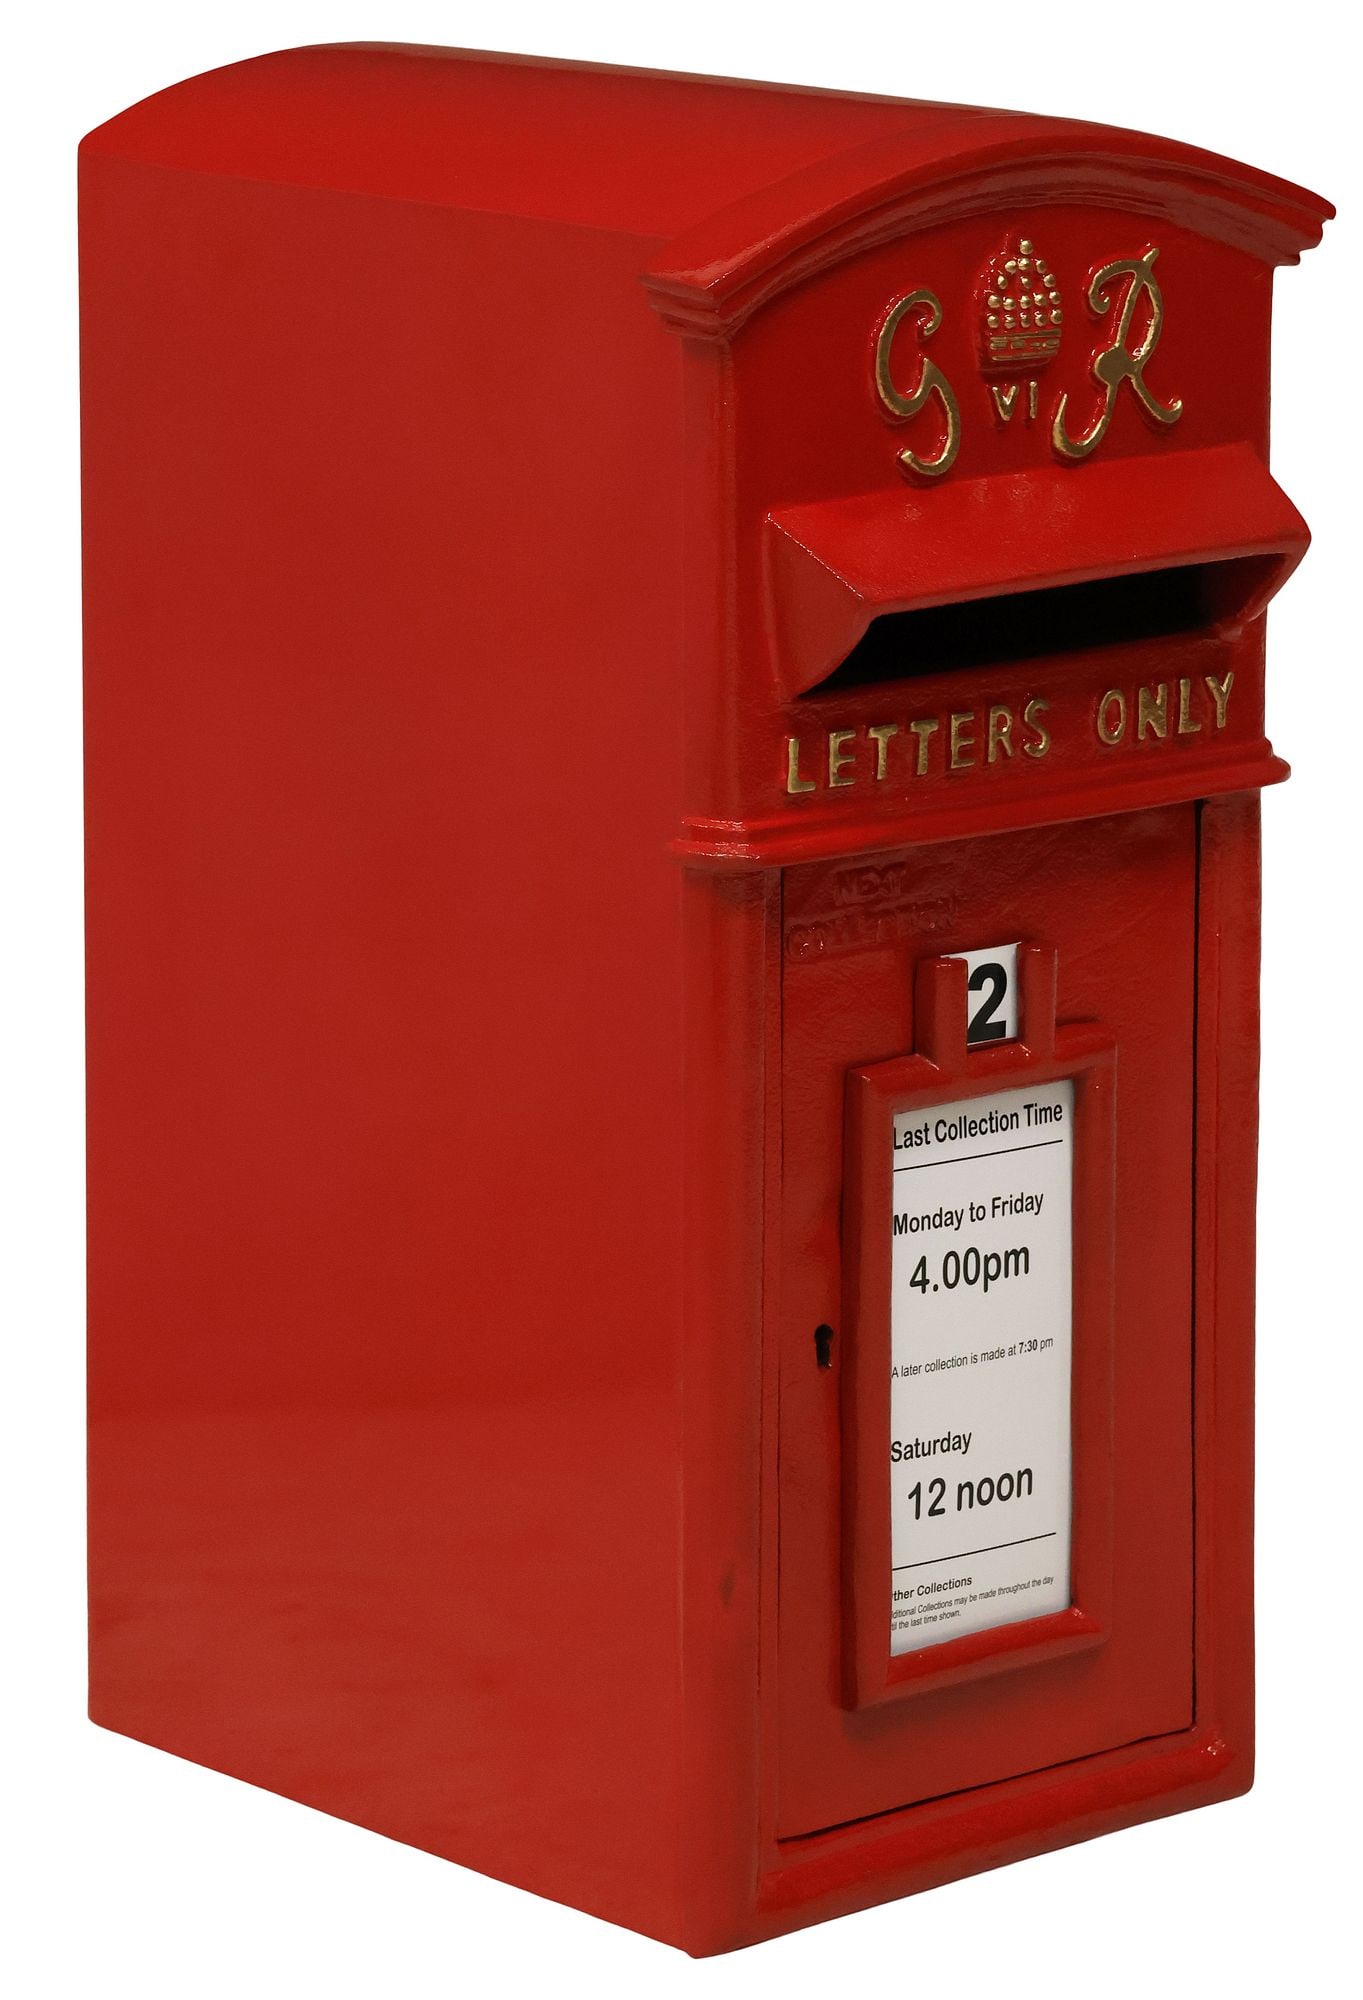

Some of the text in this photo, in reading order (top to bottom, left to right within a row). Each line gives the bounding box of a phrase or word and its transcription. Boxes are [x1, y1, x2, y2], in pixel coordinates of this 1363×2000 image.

[876, 247, 1184, 476] G VI R
[786, 672, 1235, 794] LETTERS ONLY
[967, 962, 1008, 1044] 2
[893, 1102, 1063, 1150] Last Collection Time
[893, 1191, 1044, 1236] Monday to Friday
[909, 1246, 1030, 1294] 4.00pm
[891, 1336, 1054, 1379] A later collection is made at 7:30 pm
[891, 1431, 973, 1462] Saturday
[908, 1467, 1033, 1521] 12 noon
[891, 1575, 1055, 1620] ditional Collections may be made throughout the day
[892, 1576, 973, 1602] ther Collections
[898, 1618, 910, 1629] the
[910, 1614, 923, 1627] last
[923, 1611, 938, 1625] time
[938, 1609, 962, 1622] shown.
